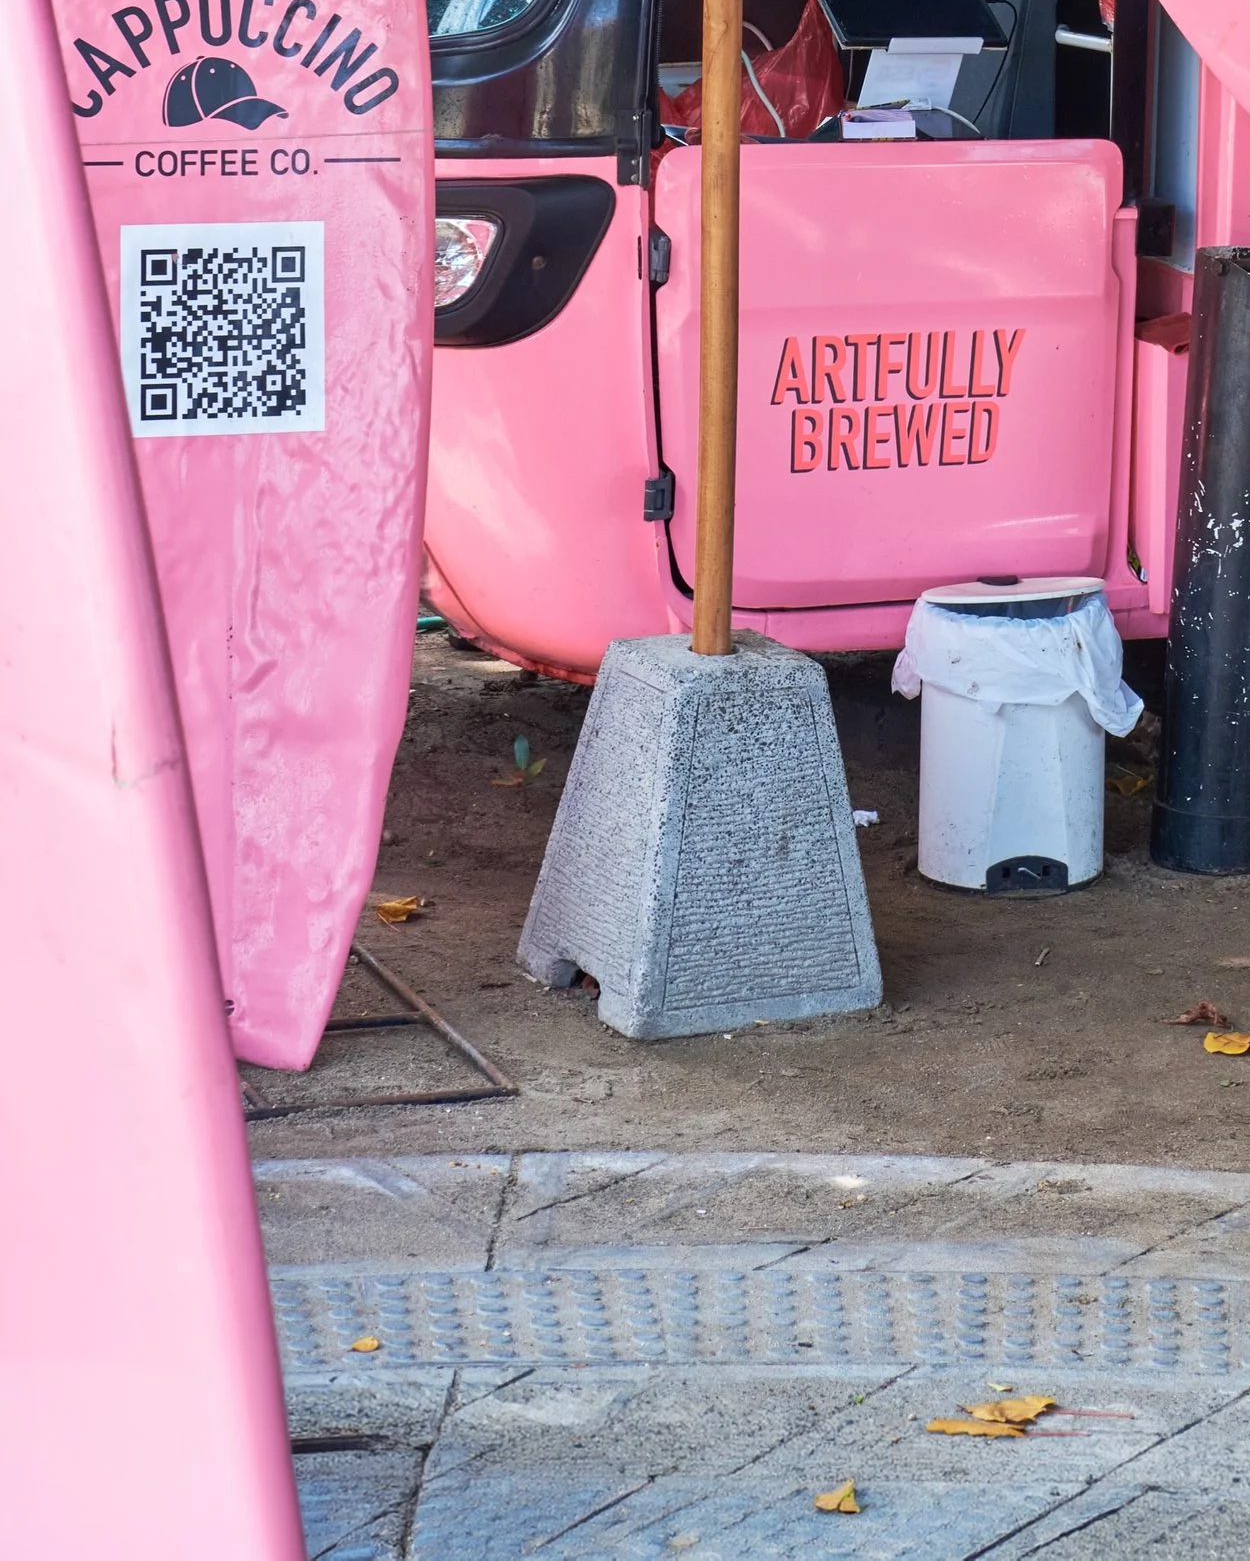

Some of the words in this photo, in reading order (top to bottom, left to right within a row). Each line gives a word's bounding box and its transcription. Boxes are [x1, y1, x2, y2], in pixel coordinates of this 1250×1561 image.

[135, 150, 259, 177] COFFEE
[270, 148, 319, 176] CO.
[770, 328, 1027, 405] ARTFULLY
[790, 401, 1000, 474] BREWED
